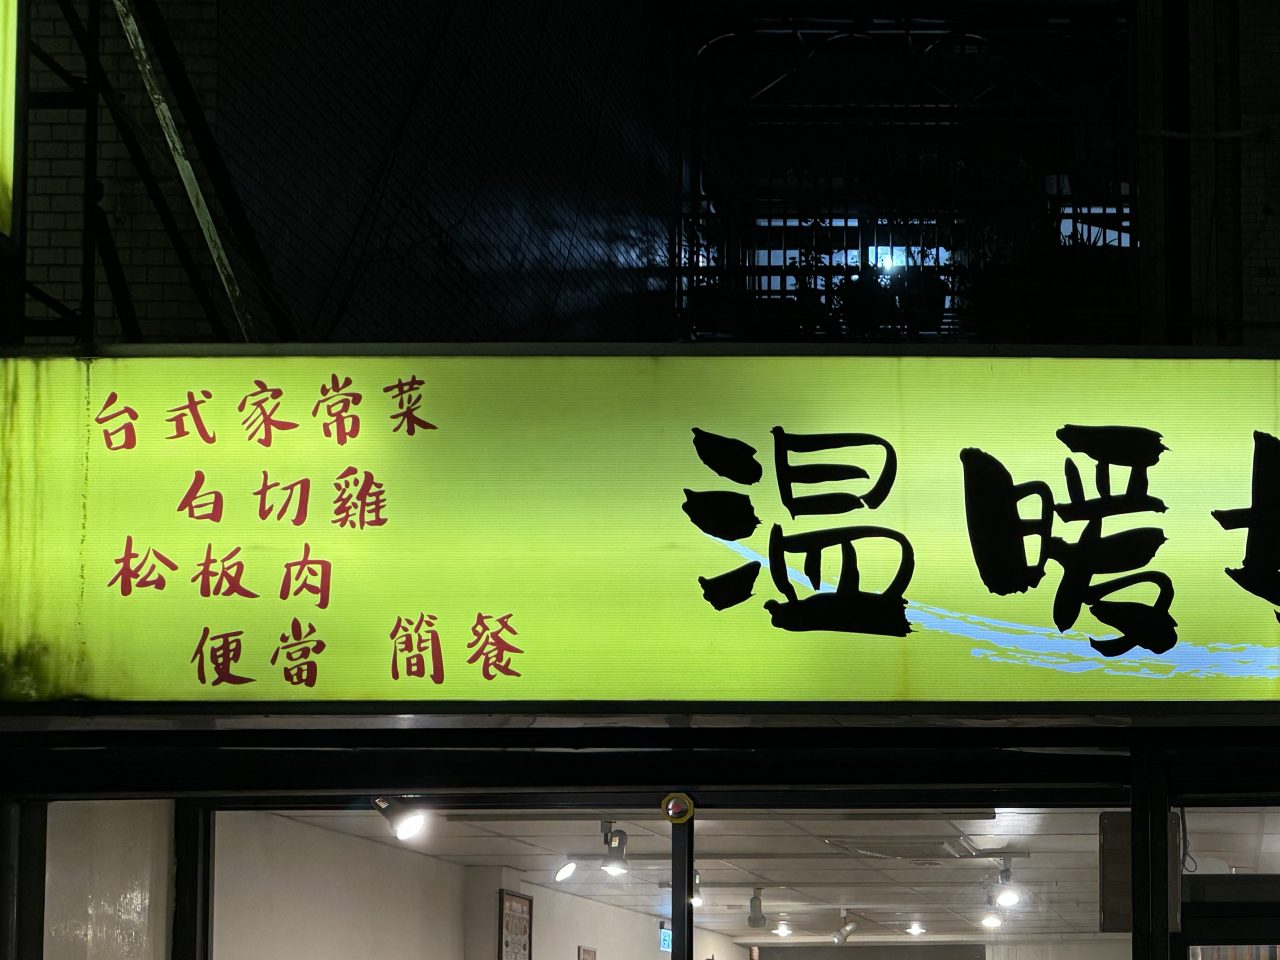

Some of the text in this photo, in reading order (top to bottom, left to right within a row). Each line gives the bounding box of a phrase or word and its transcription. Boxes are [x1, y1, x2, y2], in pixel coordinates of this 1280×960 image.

[97, 374, 439, 450] 台式家常菜
[177, 466, 389, 529] 白切雞
[107, 535, 332, 610] 松板肉
[189, 611, 524, 687] 便當 簡餐
